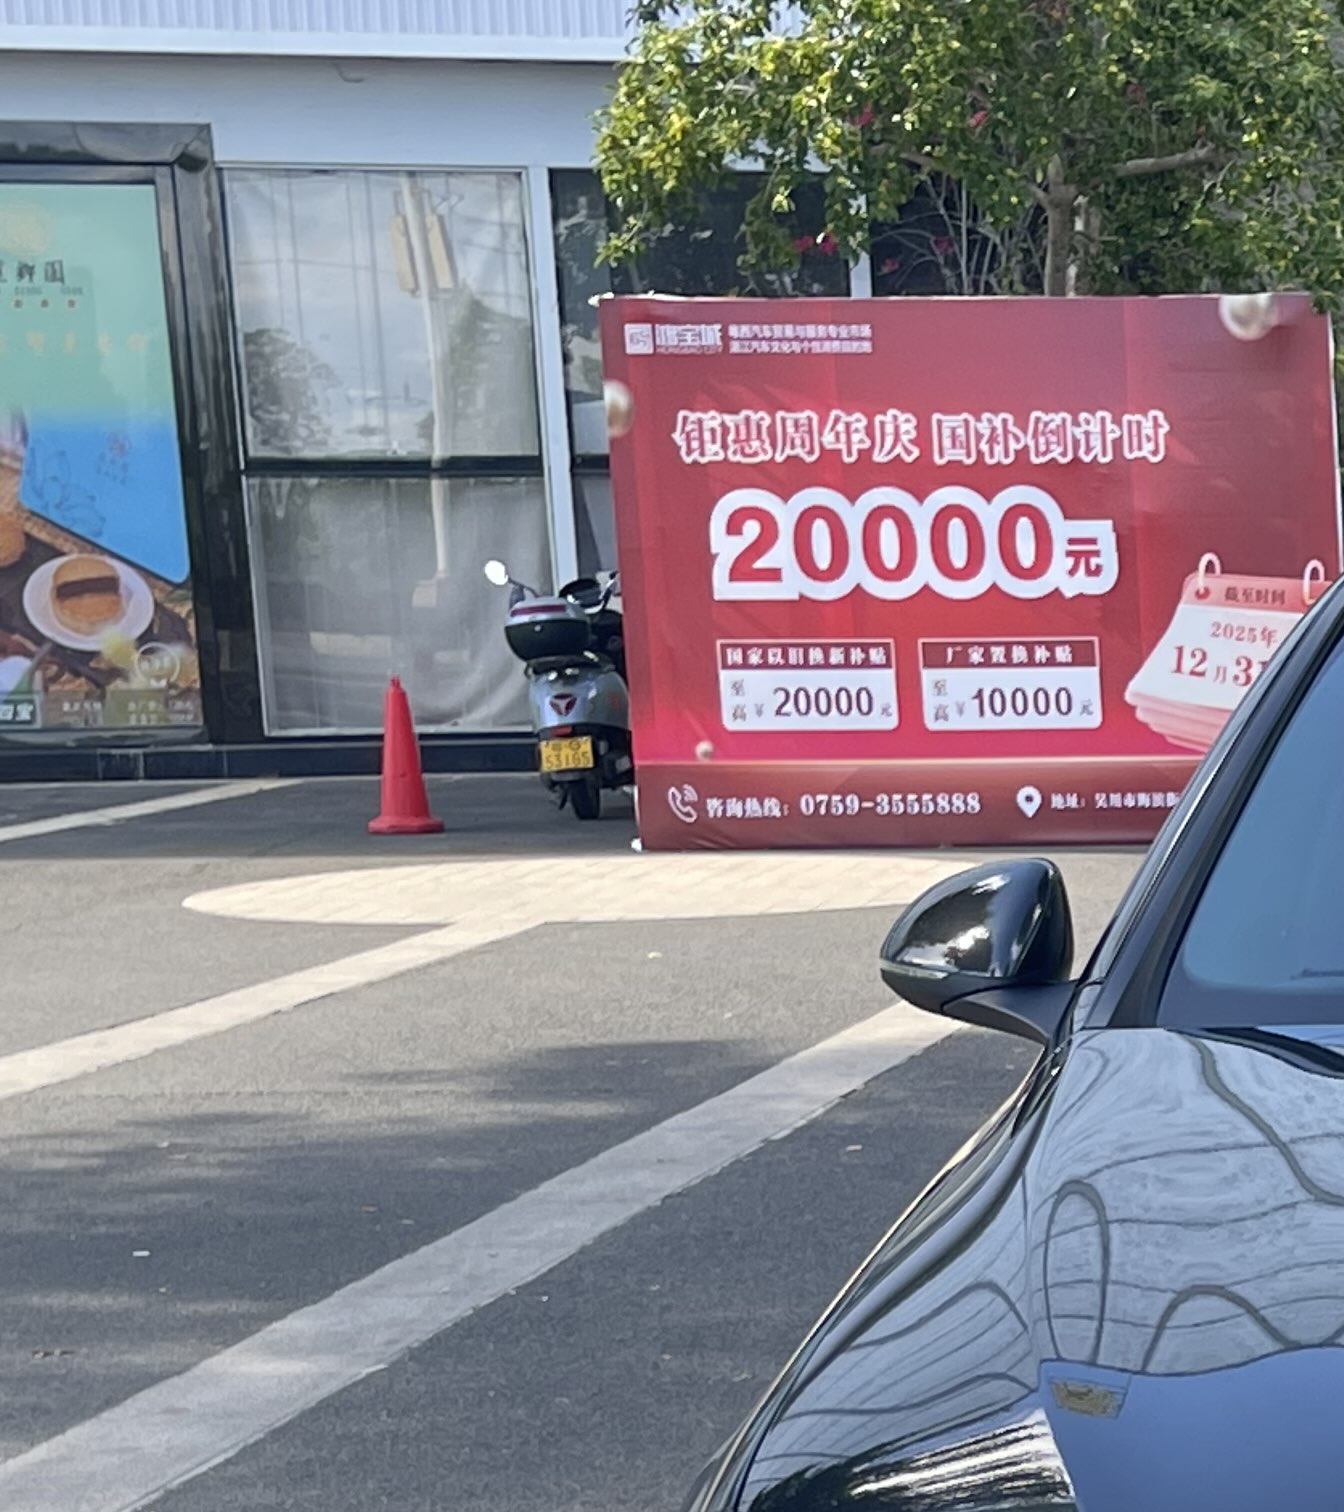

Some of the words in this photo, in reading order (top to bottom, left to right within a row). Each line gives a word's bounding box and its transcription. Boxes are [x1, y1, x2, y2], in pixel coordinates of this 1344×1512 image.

[673, 410, 920, 463] 钜惠周年庆
[931, 410, 1170, 464] 国补倒计时
[721, 498, 1105, 587] 20000元
[1210, 621, 1277, 646] 2025年
[800, 792, 981, 816] 0759-3555888
